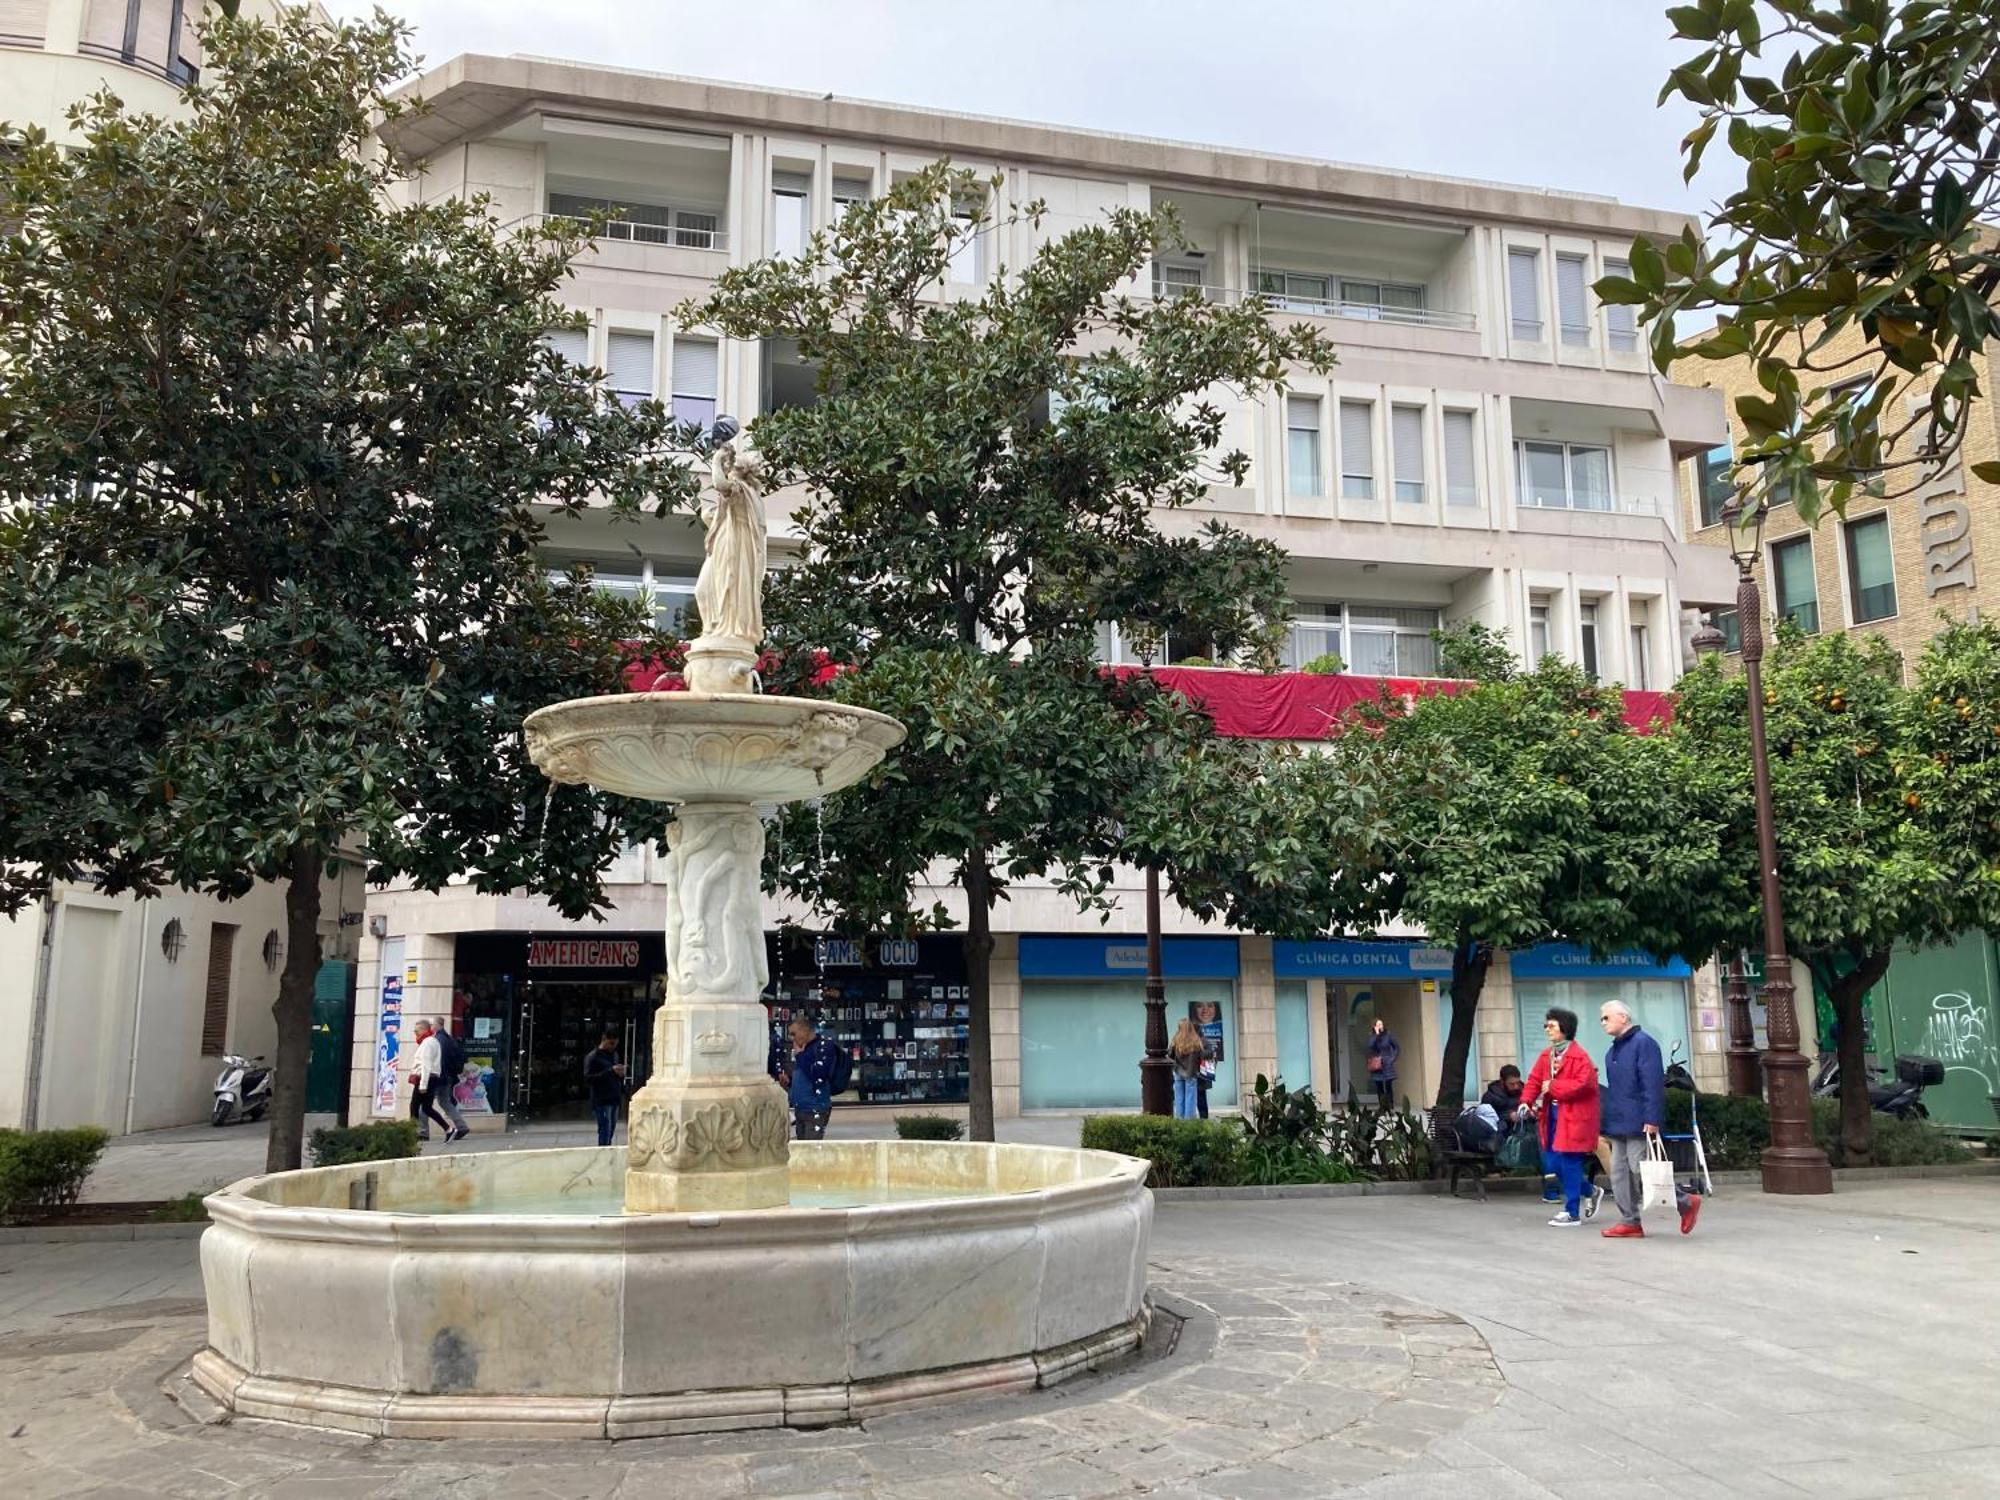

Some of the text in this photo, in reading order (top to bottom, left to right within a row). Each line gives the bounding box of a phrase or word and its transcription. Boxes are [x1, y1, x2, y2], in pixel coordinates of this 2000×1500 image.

[528, 940, 640, 967] AMERICAN'S
[880, 939, 919, 966] OCIO
[1296, 951, 1349, 965] CLÍNICA
[1353, 953, 1402, 965] DENTAL
